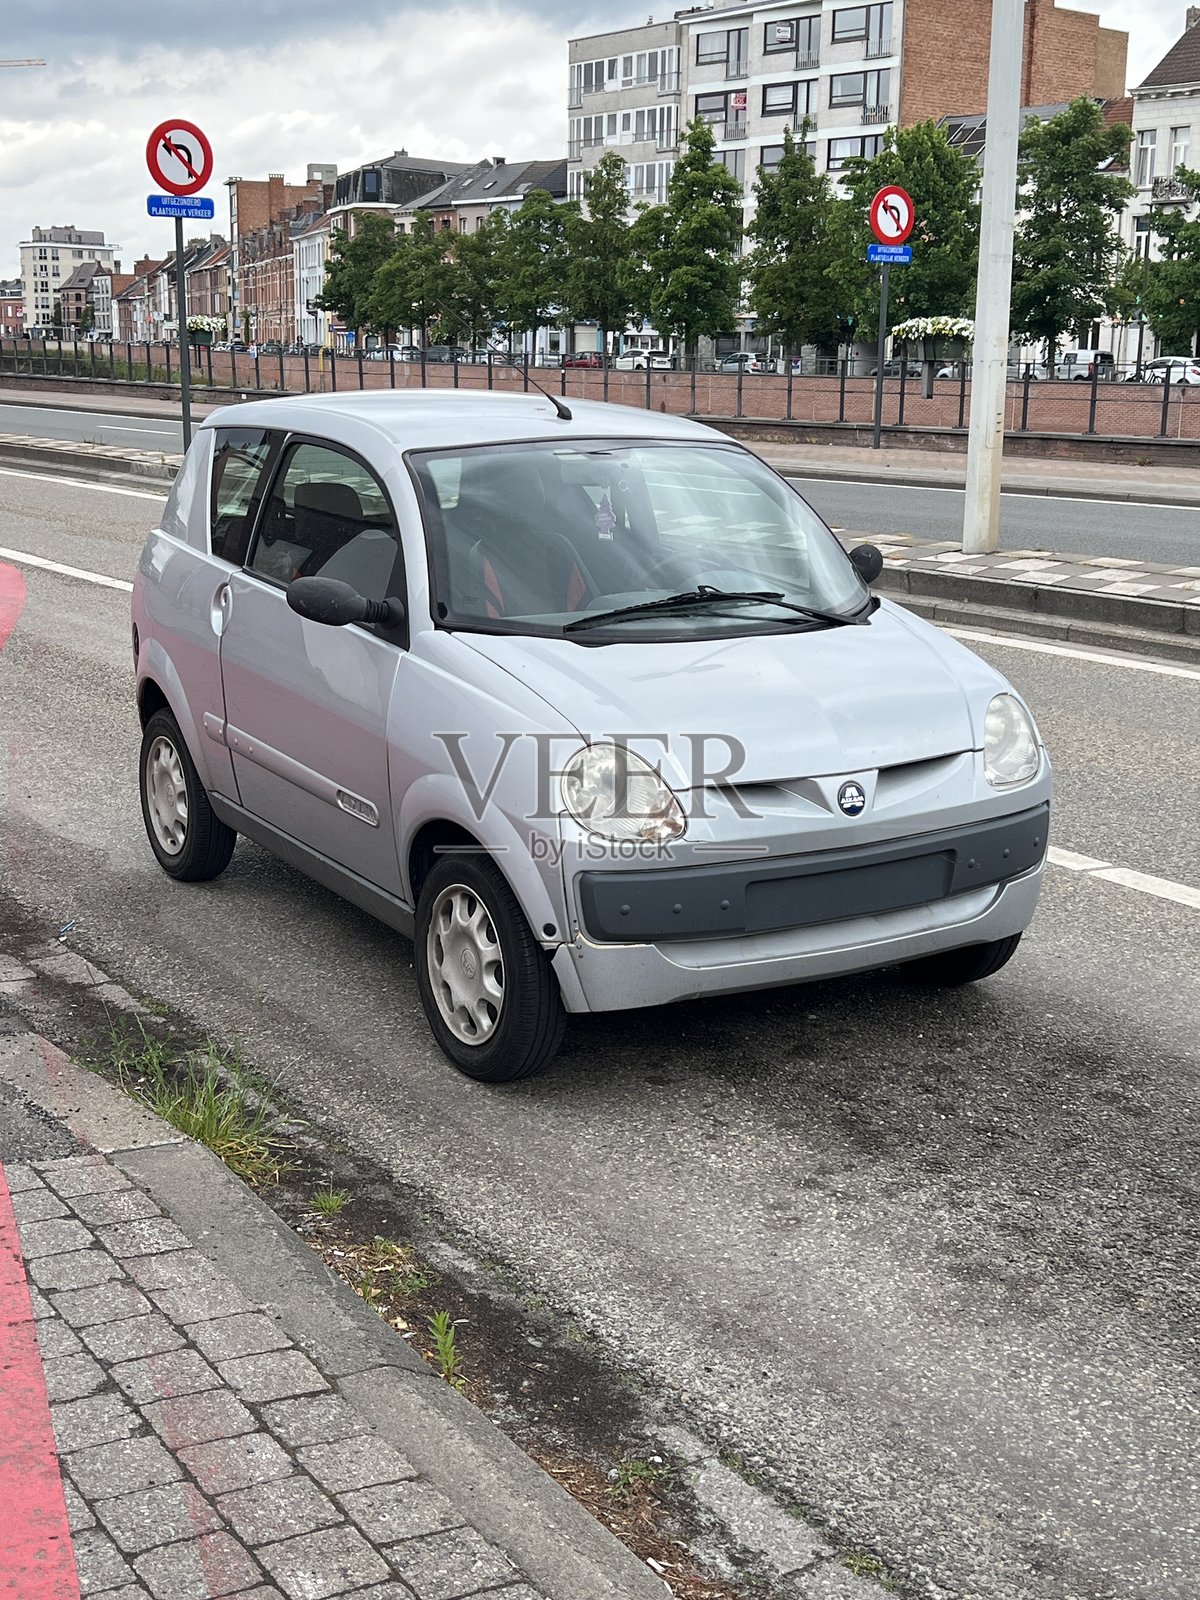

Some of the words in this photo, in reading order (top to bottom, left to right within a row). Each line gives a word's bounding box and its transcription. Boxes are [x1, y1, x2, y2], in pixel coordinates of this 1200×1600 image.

[161, 198, 202, 206] UITGEZONDERD
[152, 206, 186, 216] PLAATSELIJK
[188, 208, 212, 218] VERKEER
